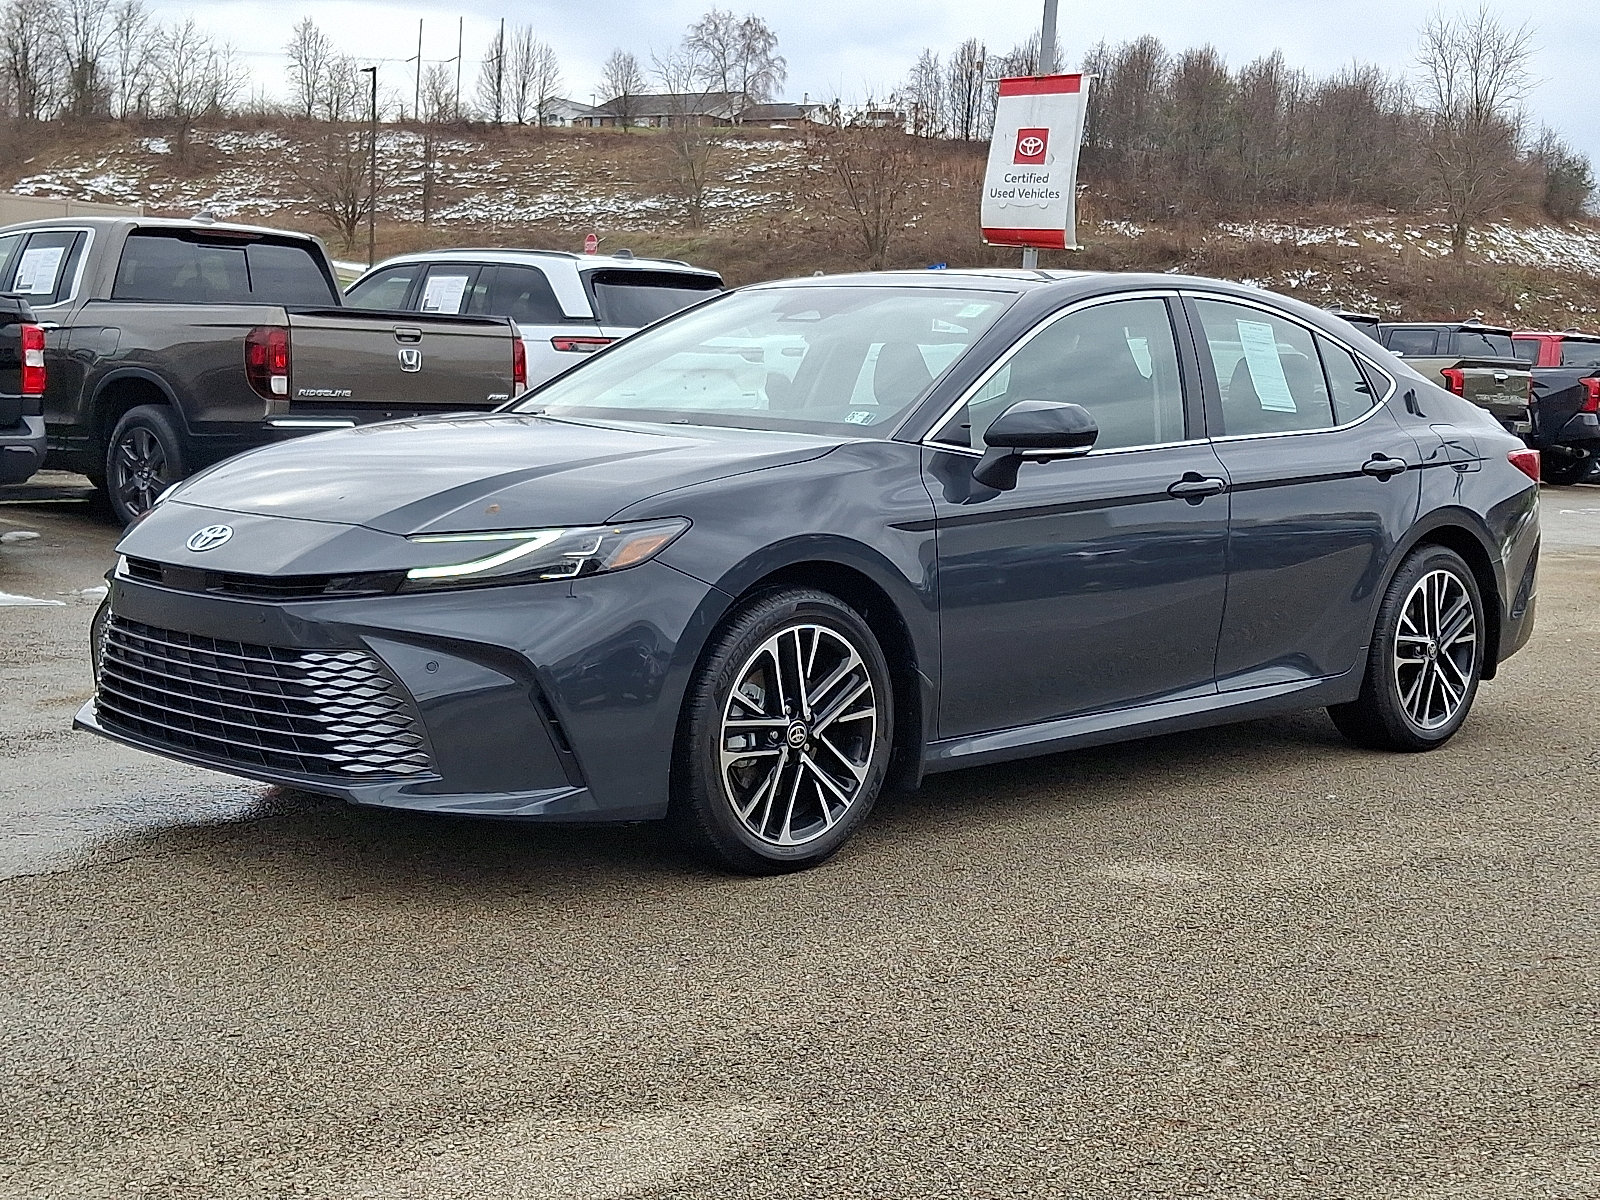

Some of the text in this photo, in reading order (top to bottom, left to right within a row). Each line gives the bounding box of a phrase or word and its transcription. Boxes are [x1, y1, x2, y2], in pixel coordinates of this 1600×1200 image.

[1004, 172, 1050, 184] Certified
[990, 187, 1061, 199] Used Vehicles
[298, 388, 352, 398] RIDGELINE
